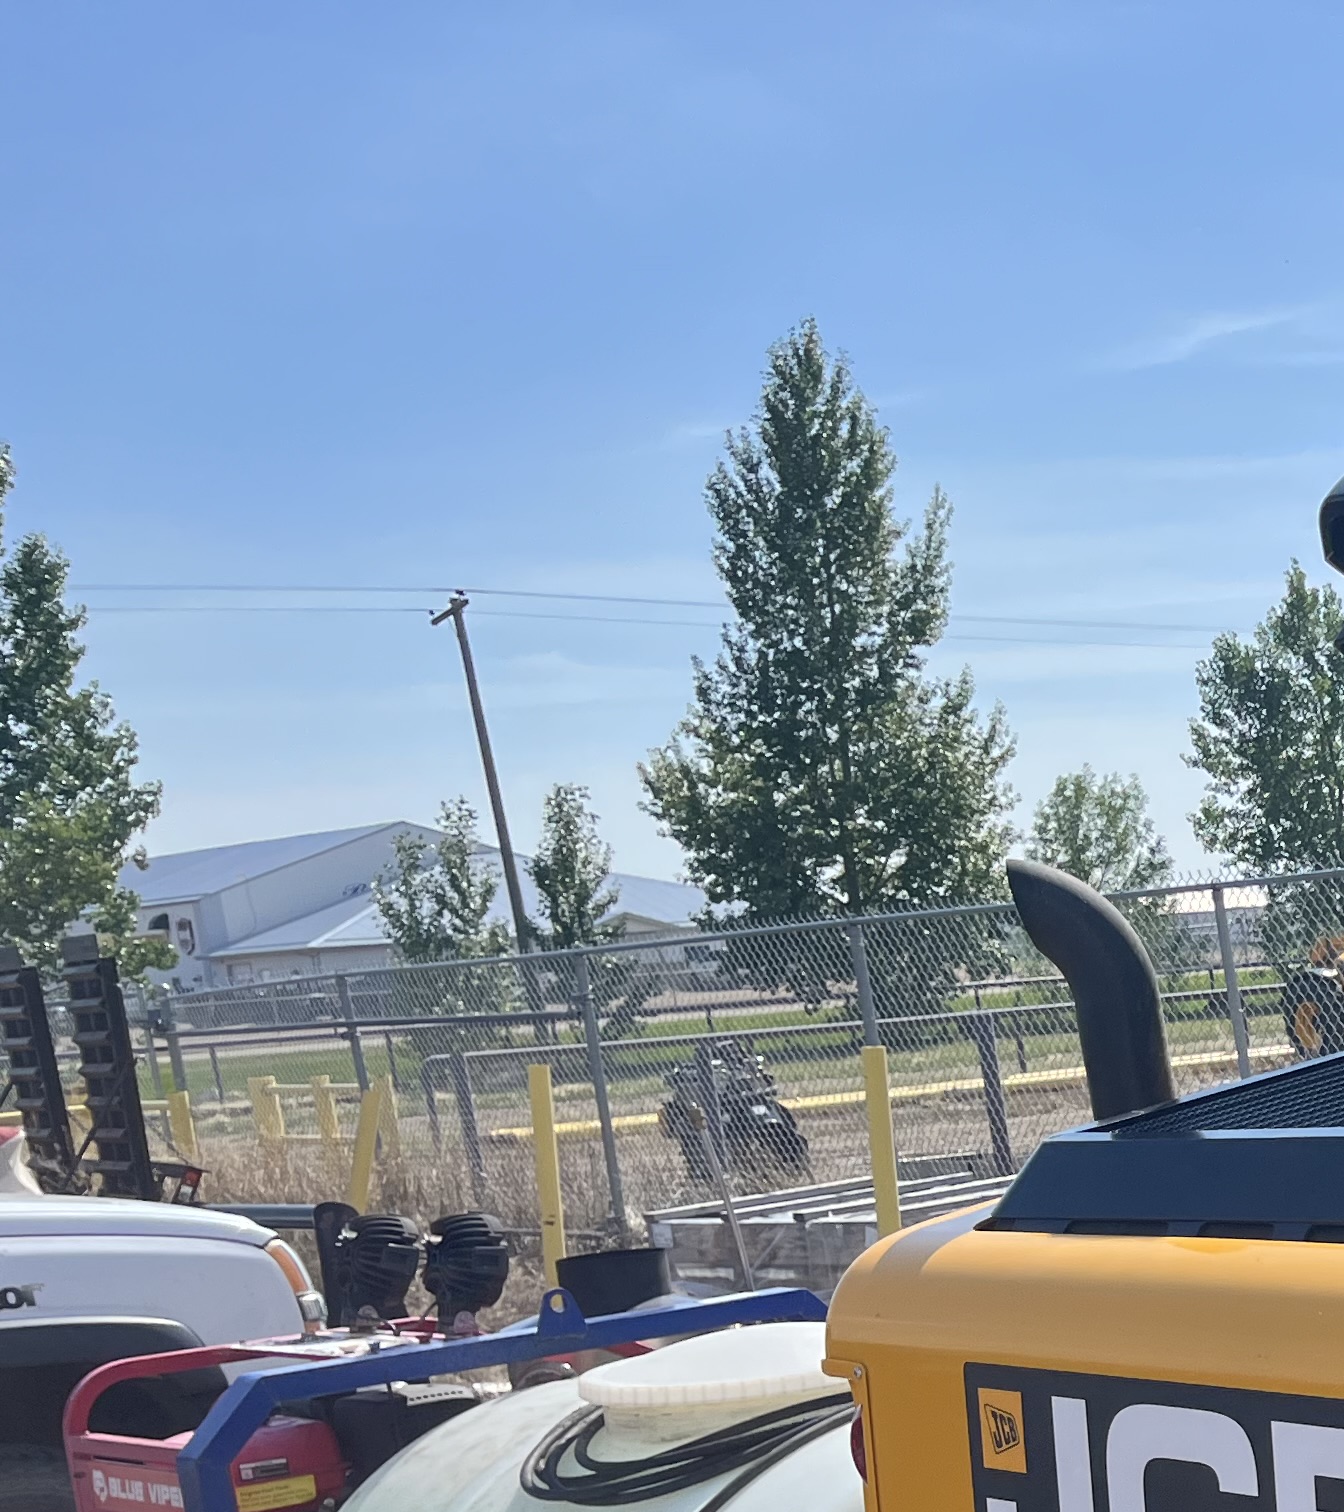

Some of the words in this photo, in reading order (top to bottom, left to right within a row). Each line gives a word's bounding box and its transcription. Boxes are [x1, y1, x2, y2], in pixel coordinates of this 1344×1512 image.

[991, 1410, 1017, 1449] JCB
[108, 1476, 145, 1502] BLUE
[147, 1482, 184, 1508] VIPE
